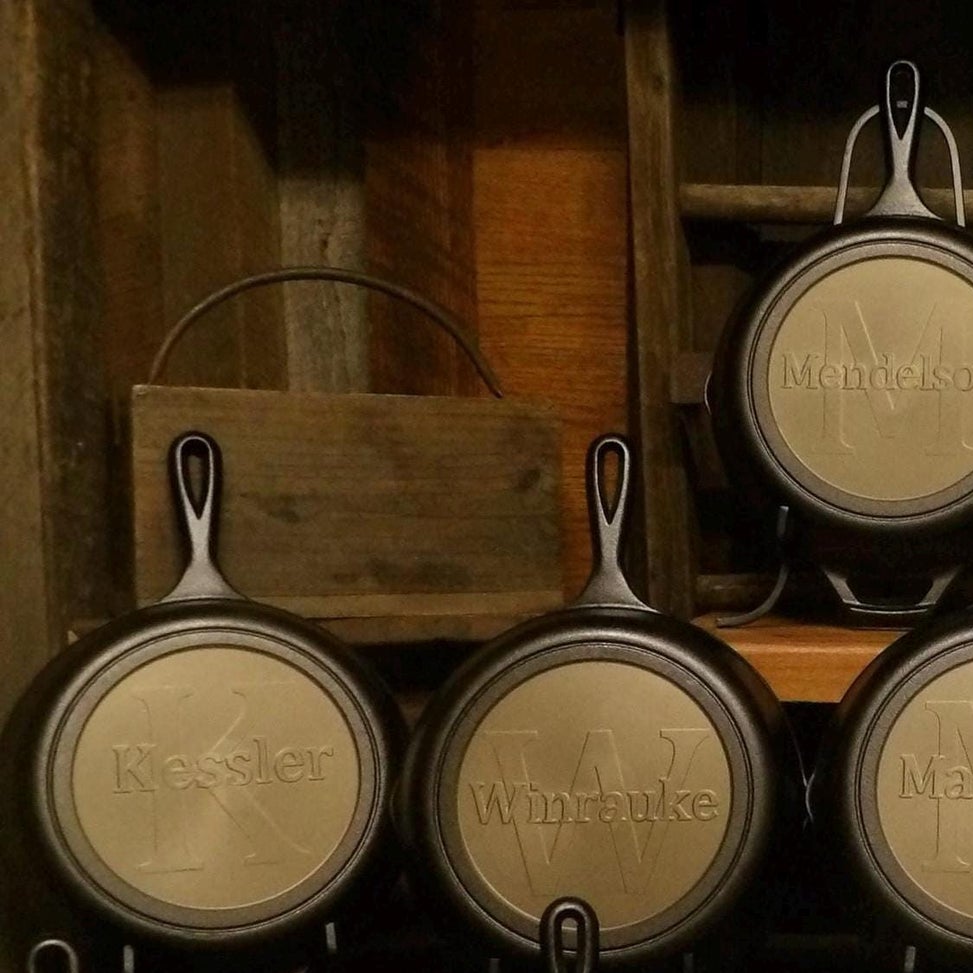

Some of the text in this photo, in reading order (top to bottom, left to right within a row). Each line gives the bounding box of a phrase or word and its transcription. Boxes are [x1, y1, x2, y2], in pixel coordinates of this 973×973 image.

[111, 735, 335, 795] Kessler
[130, 682, 312, 875] K
[469, 777, 720, 825] Winrauke
[483, 728, 711, 897] W
